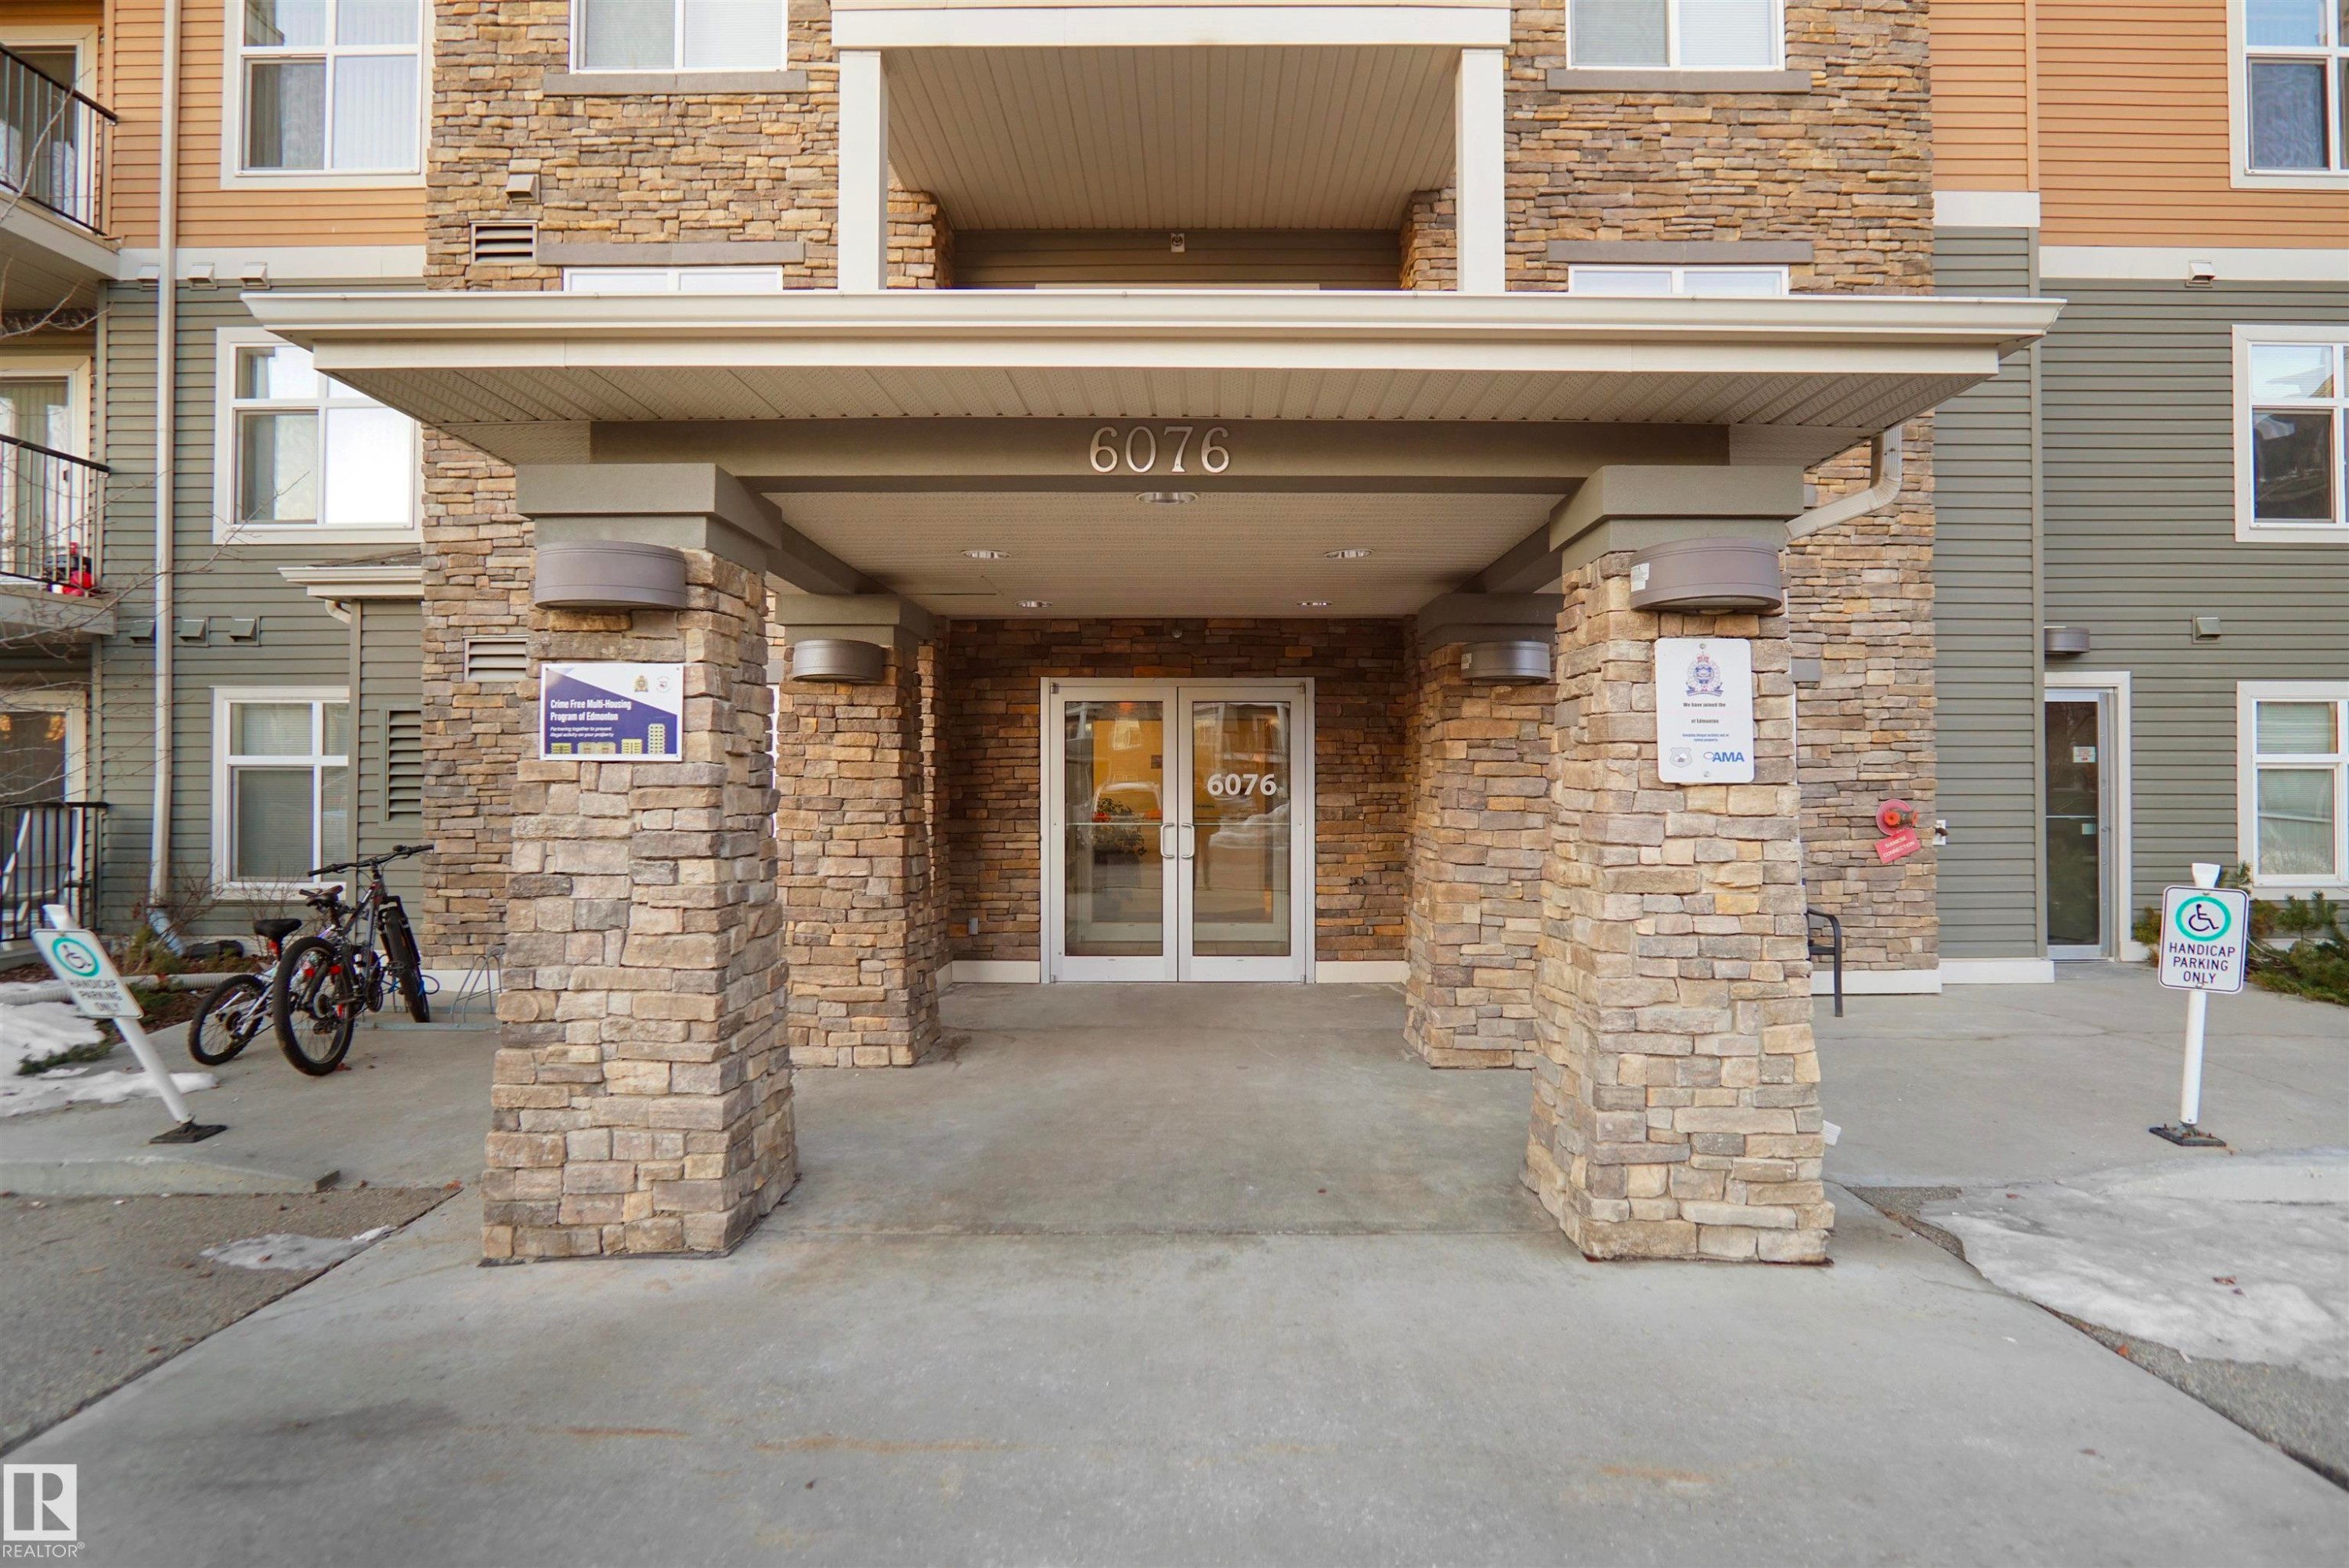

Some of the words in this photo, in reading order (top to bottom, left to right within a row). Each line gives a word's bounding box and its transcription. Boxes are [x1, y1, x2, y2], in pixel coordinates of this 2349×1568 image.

[1089, 426, 1229, 473] 6076
[550, 699, 569, 708] Crime
[570, 699, 586, 708] Free
[586, 699, 632, 710] Multi-Housing
[550, 712, 578, 723] Program
[578, 712, 586, 721] of
[586, 712, 619, 721] Edmonton
[1712, 752, 1745, 762] AMA
[1207, 773, 1277, 795] 6076
[1882, 841, 1915, 858] CONNECTION
[2169, 942, 2235, 957] HANDICAP
[2173, 956, 2228, 971] PARKING
[68, 979, 117, 989] HANDICAP
[2183, 971, 2217, 984] ONLY
[78, 990, 123, 1001] PARKING
